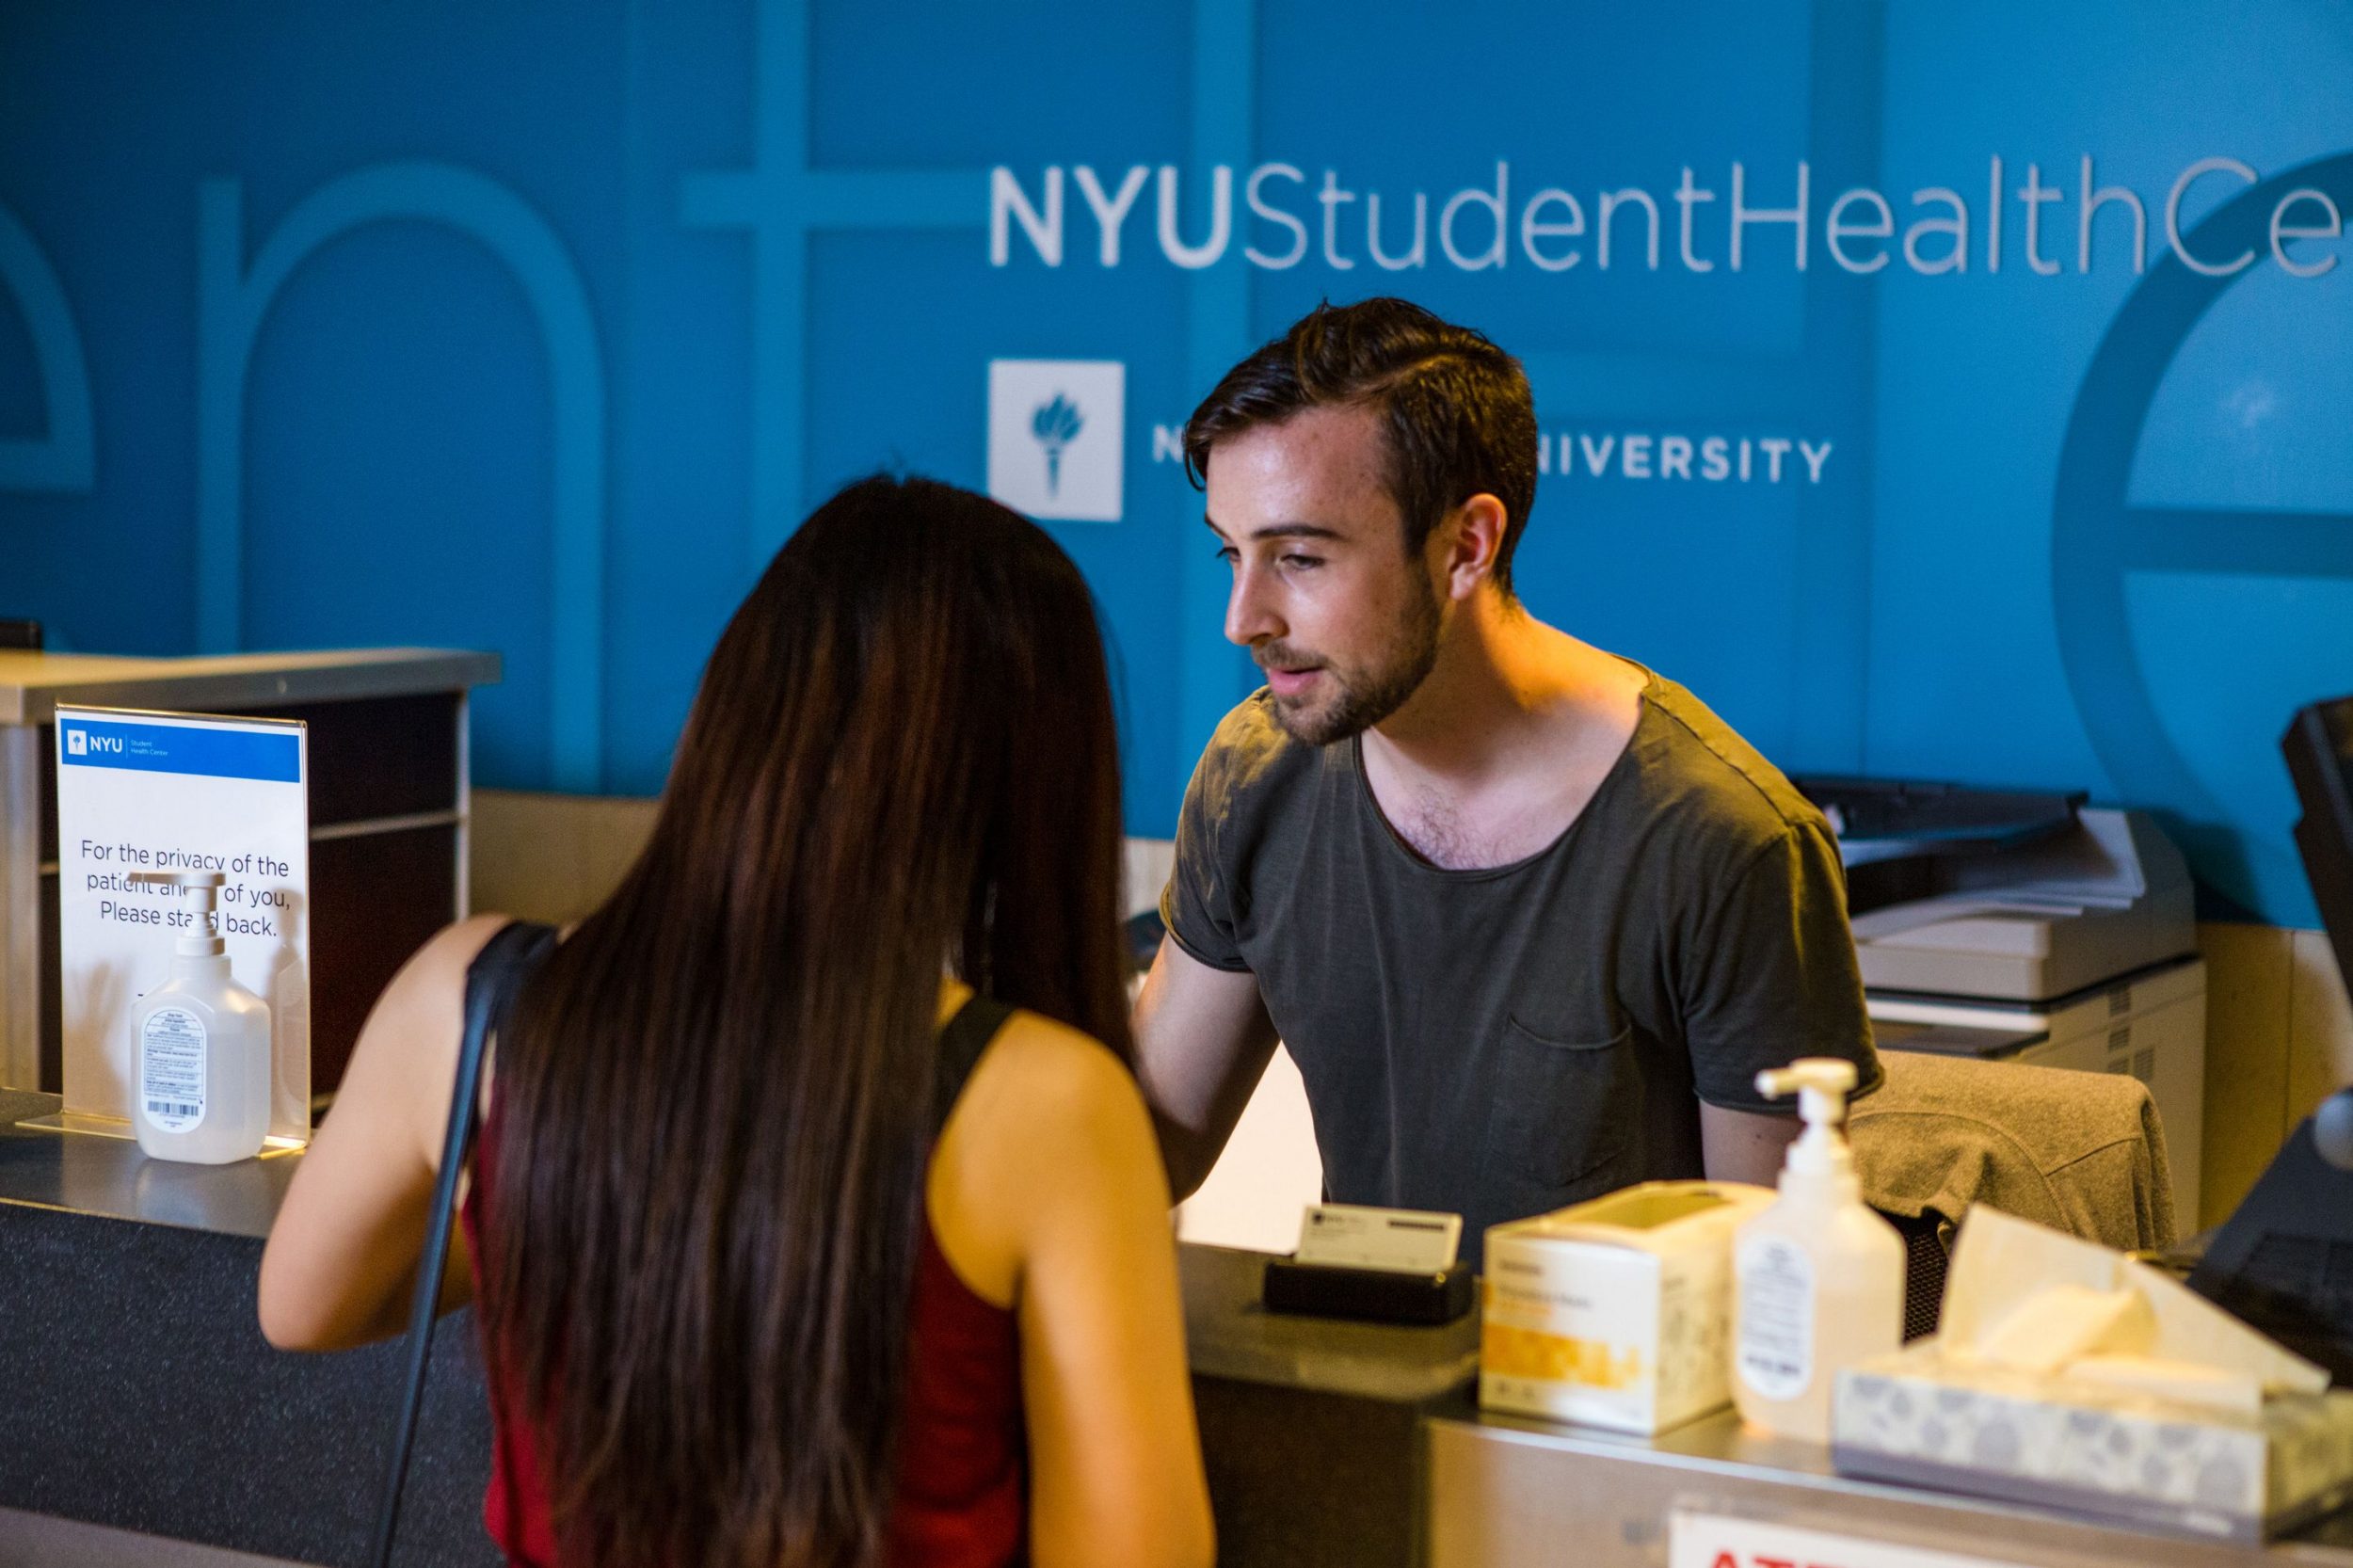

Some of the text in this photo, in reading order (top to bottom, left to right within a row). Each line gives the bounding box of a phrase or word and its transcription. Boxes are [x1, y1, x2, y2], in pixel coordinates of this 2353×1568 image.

[1539, 434, 1833, 482] IVERSITY
[89, 736, 123, 753] NYU
[81, 840, 289, 876] For the privacy of the
[224, 884, 244, 902] of
[249, 890, 290, 910] you,
[101, 901, 278, 936] Please stad back.
